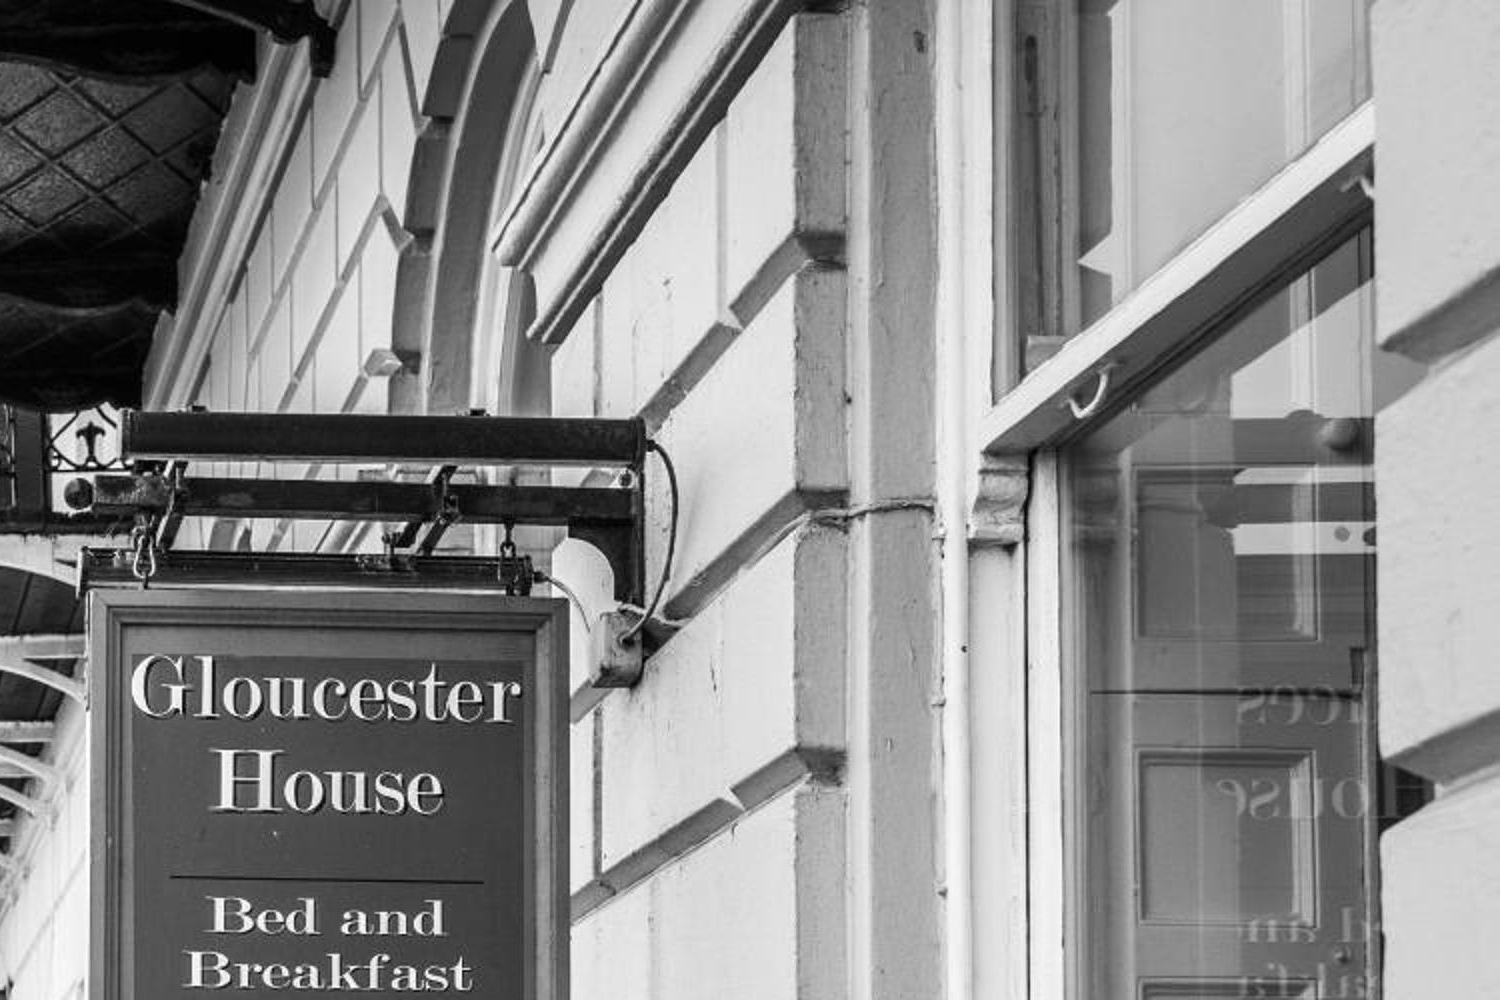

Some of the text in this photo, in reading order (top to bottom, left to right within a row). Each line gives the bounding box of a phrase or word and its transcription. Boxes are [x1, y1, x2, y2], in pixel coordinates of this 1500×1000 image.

[131, 654, 521, 724] Gloucester
[209, 748, 445, 815] House
[205, 895, 446, 937] Bed and
[181, 950, 474, 992] Breakfast
